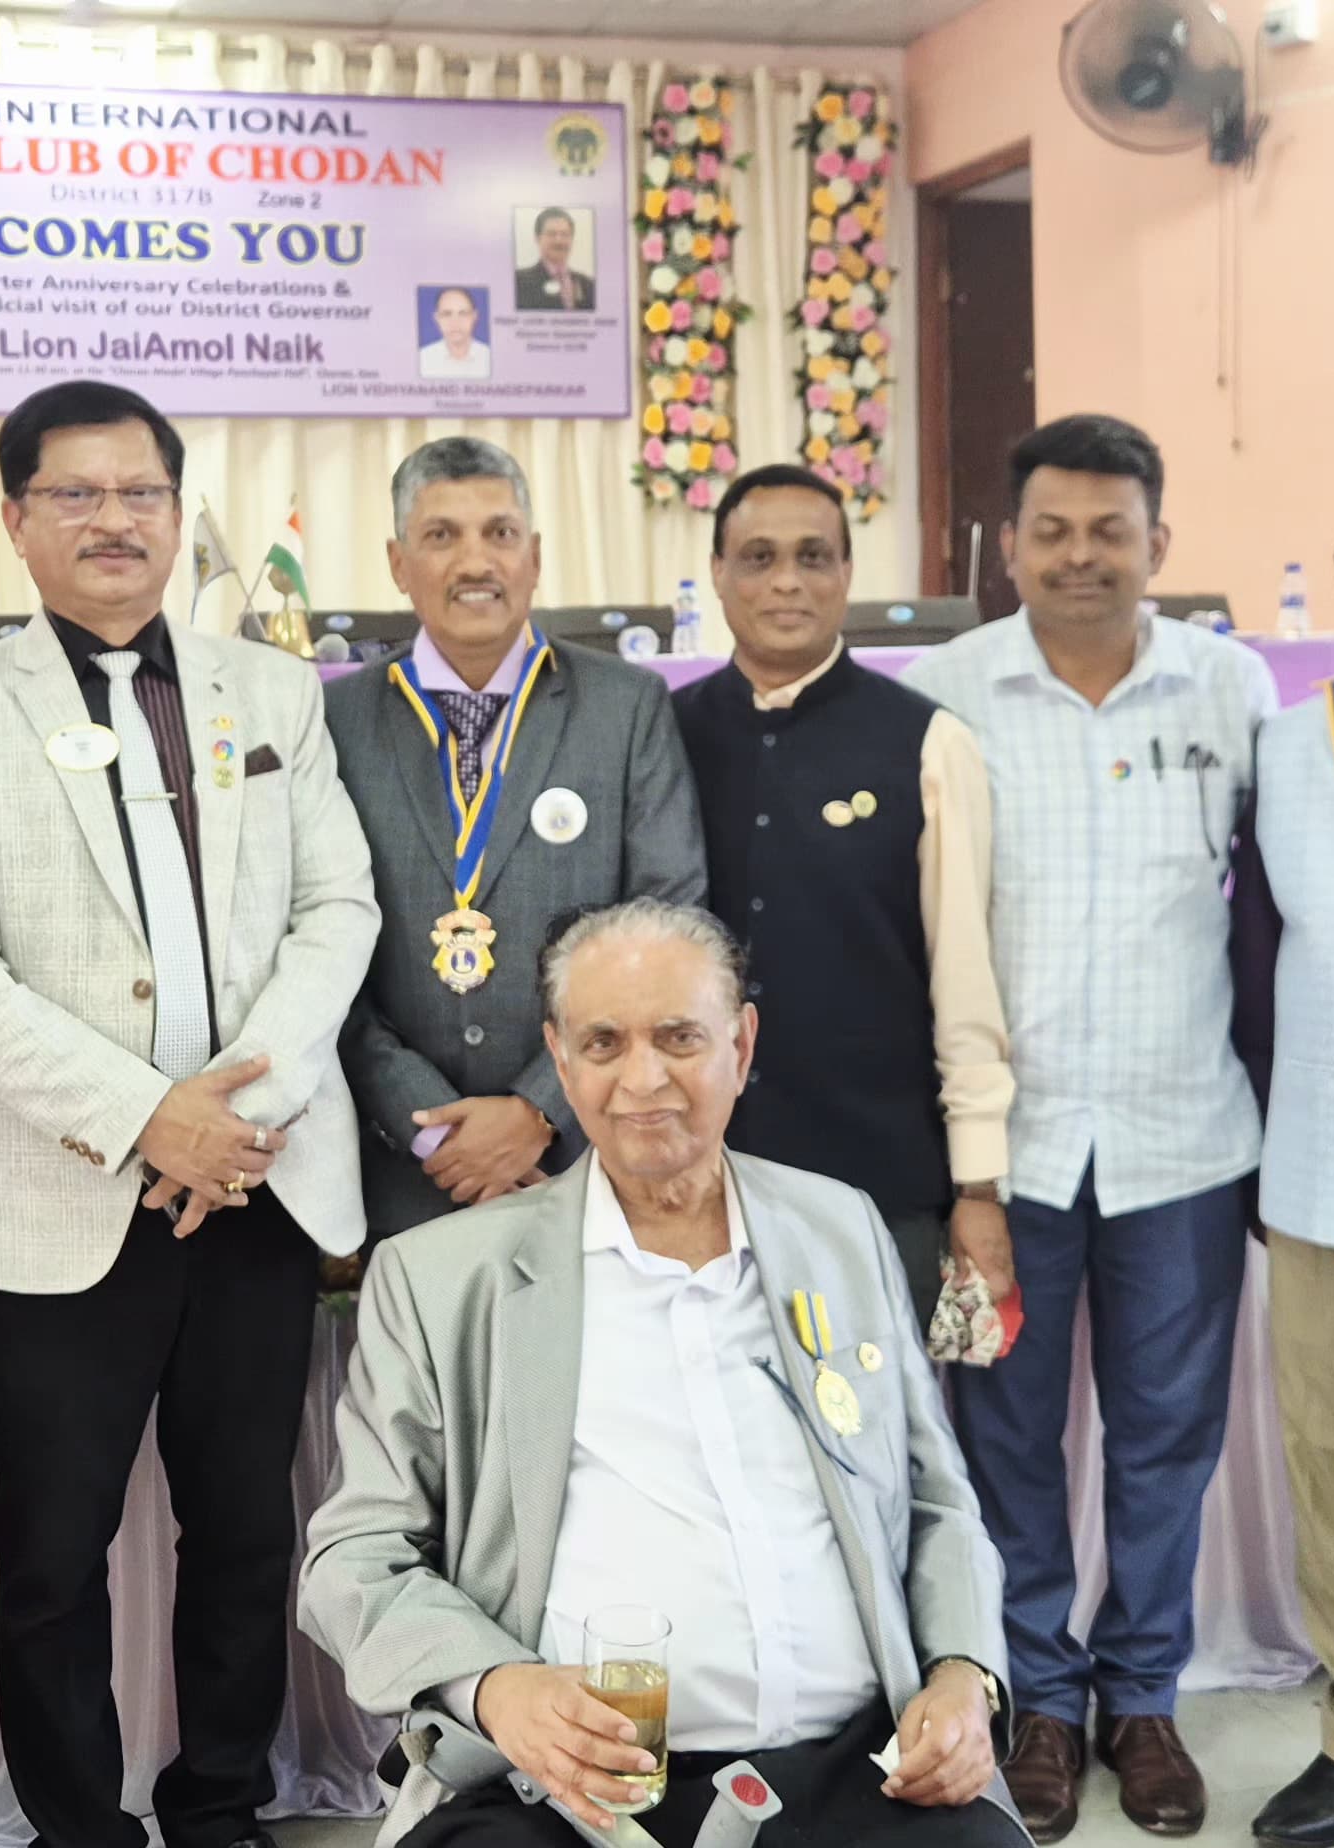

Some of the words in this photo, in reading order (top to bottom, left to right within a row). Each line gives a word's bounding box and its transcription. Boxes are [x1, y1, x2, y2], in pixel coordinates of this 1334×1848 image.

[117, 139, 194, 179] OF
[207, 142, 447, 187] CHODAN
[50, 183, 140, 202] District
[154, 186, 213, 206] 317B
[258, 190, 306, 209] Zone
[310, 192, 322, 210] 2
[230, 221, 367, 267] YOU
[42, 274, 179, 297] Anniversary
[186, 277, 328, 298] Celebrations
[332, 279, 353, 298] &
[51, 299, 97, 317] visit
[105, 300, 127, 317] of
[135, 303, 173, 318] our
[181, 301, 262, 320] District
[267, 303, 373, 323] Governor
[0, 328, 77, 360] Lion
[87, 330, 235, 364] JaiAmol
[245, 332, 327, 365] Naik
